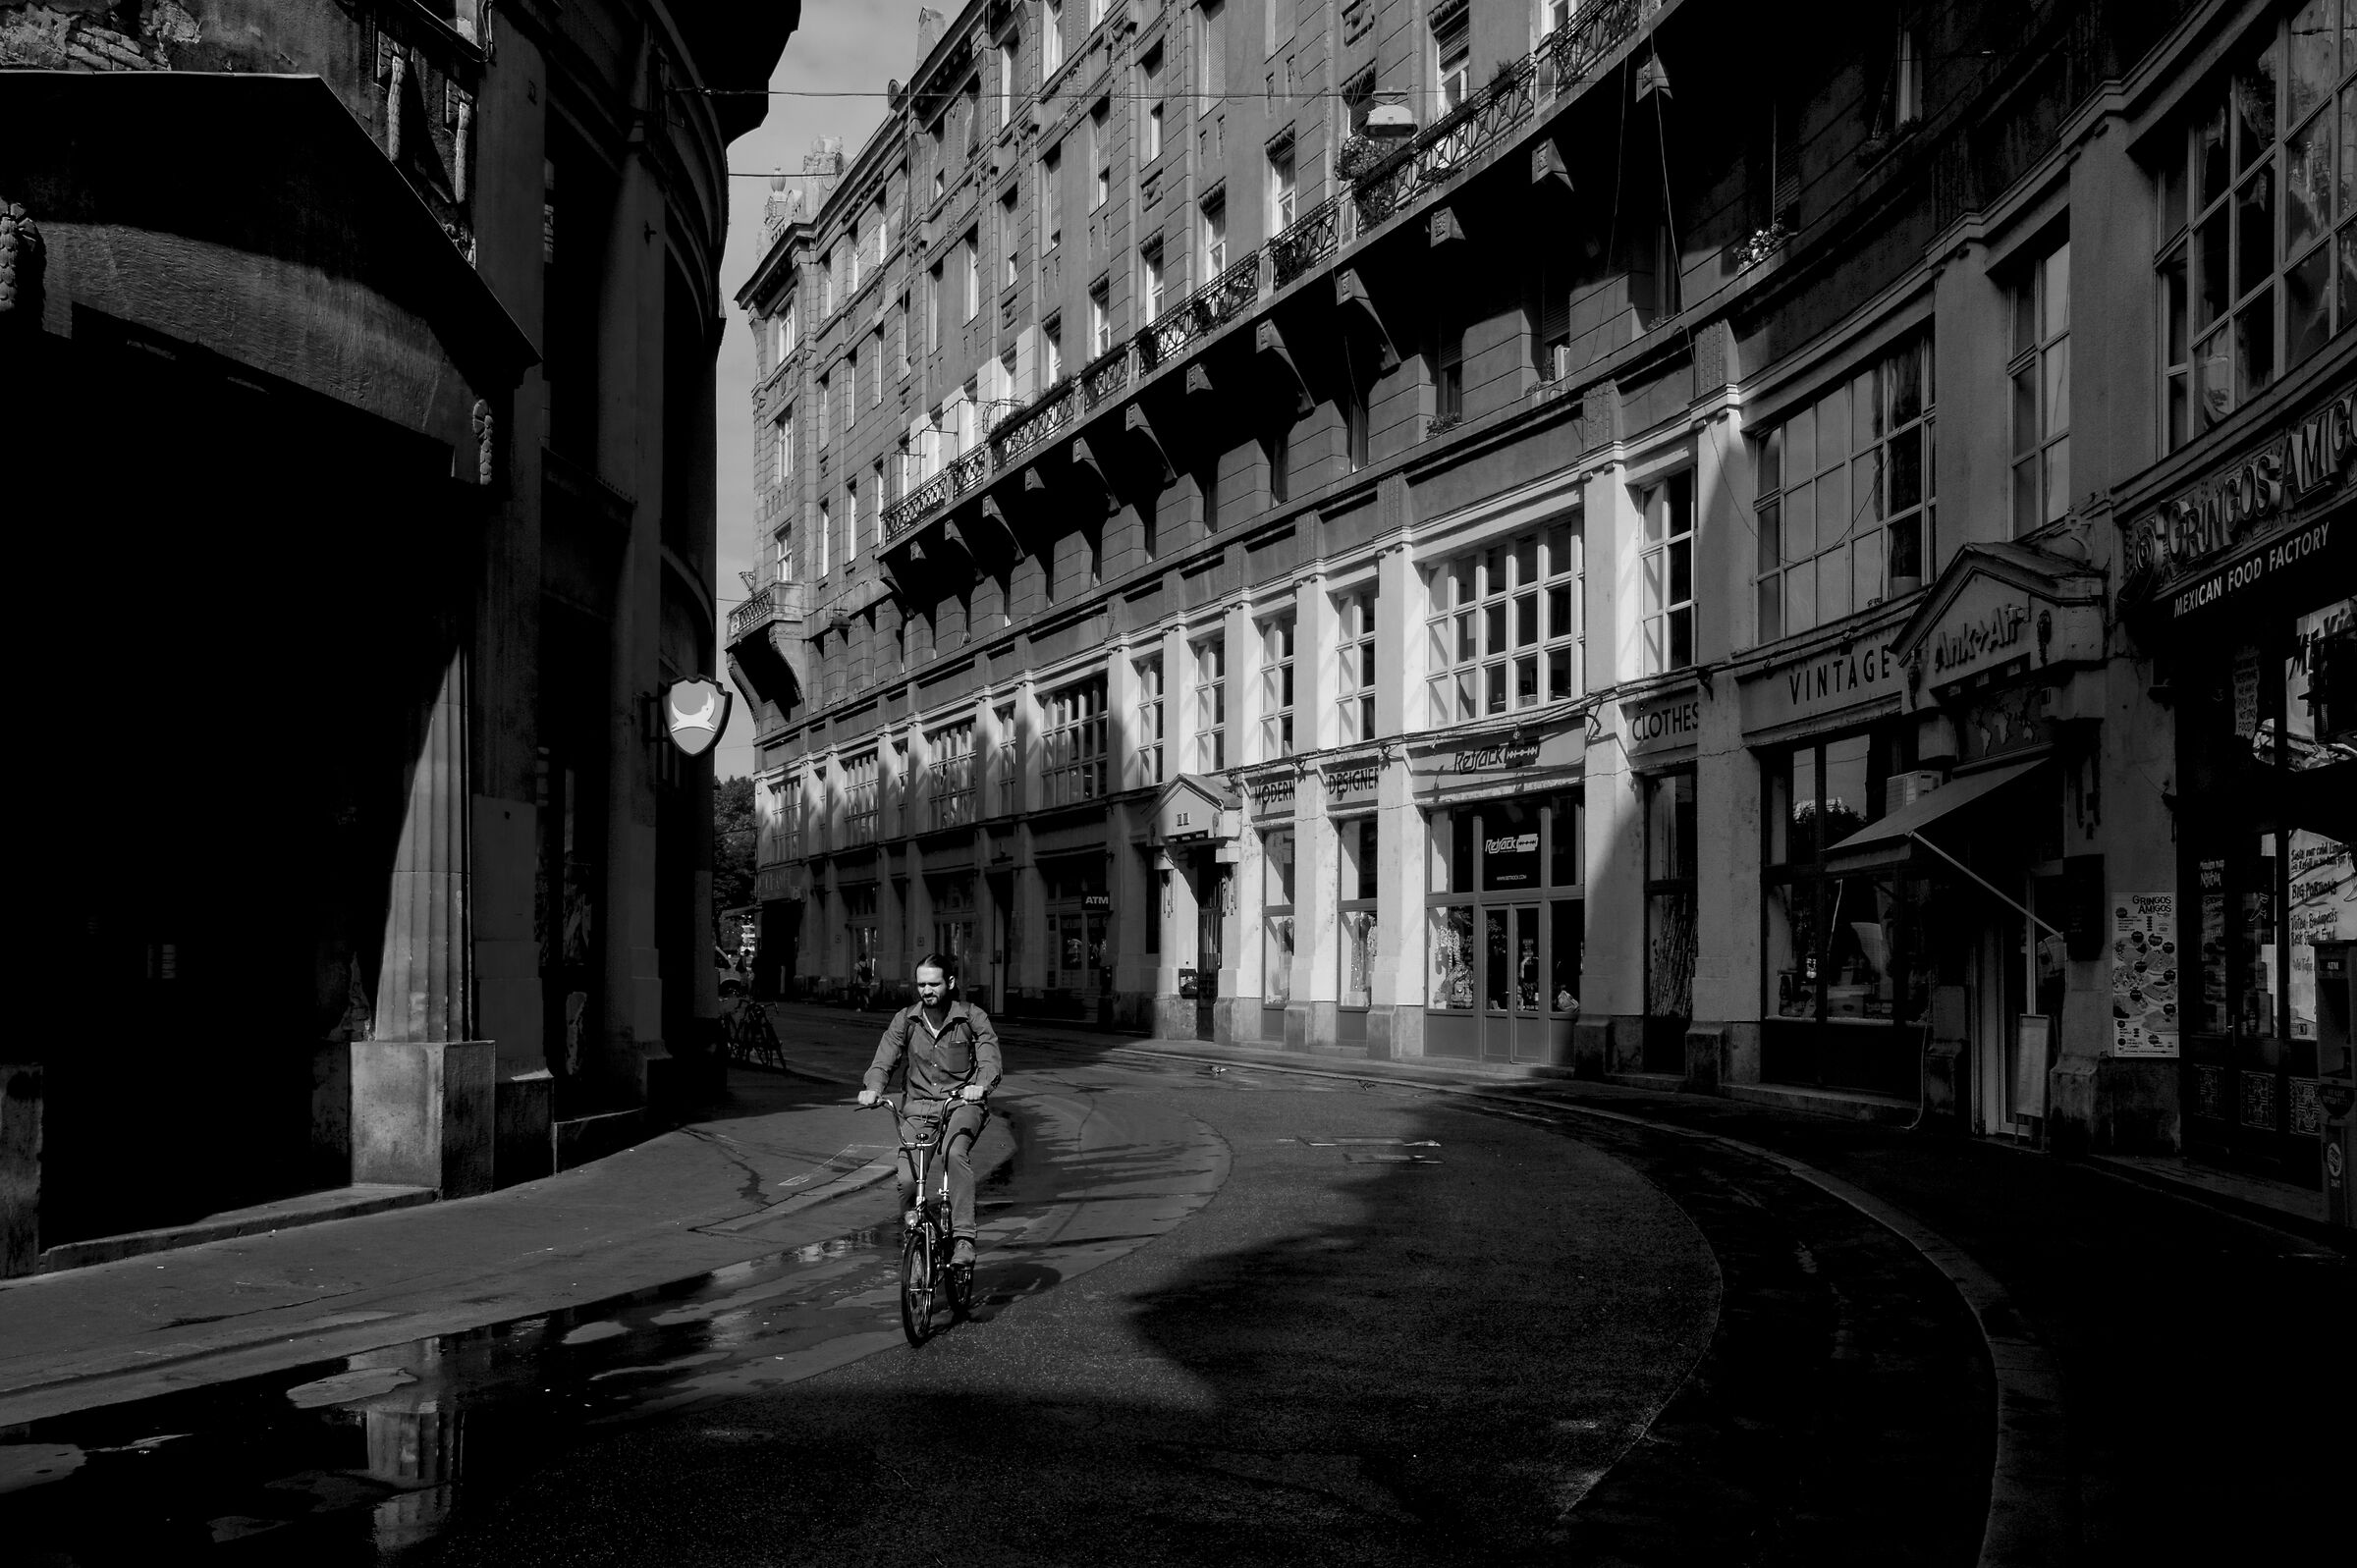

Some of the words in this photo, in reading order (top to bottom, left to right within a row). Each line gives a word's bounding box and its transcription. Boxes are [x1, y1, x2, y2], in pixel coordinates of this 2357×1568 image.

[2166, 455, 2280, 565] GRINGOS
[2174, 576, 2222, 618] MEXICAN
[2228, 557, 2263, 592] FOOD
[2269, 522, 2330, 572] FACTORY
[1789, 645, 1891, 705] VINTAGE
[1632, 702, 1698, 741] CLOTHES
[1255, 781, 1295, 805] MODERN
[1085, 895, 1109, 904] ATM
[2132, 894, 2171, 905] GRINGOS
[2138, 904, 2171, 914] AMIGOS
[2327, 961, 2339, 970] ATM
